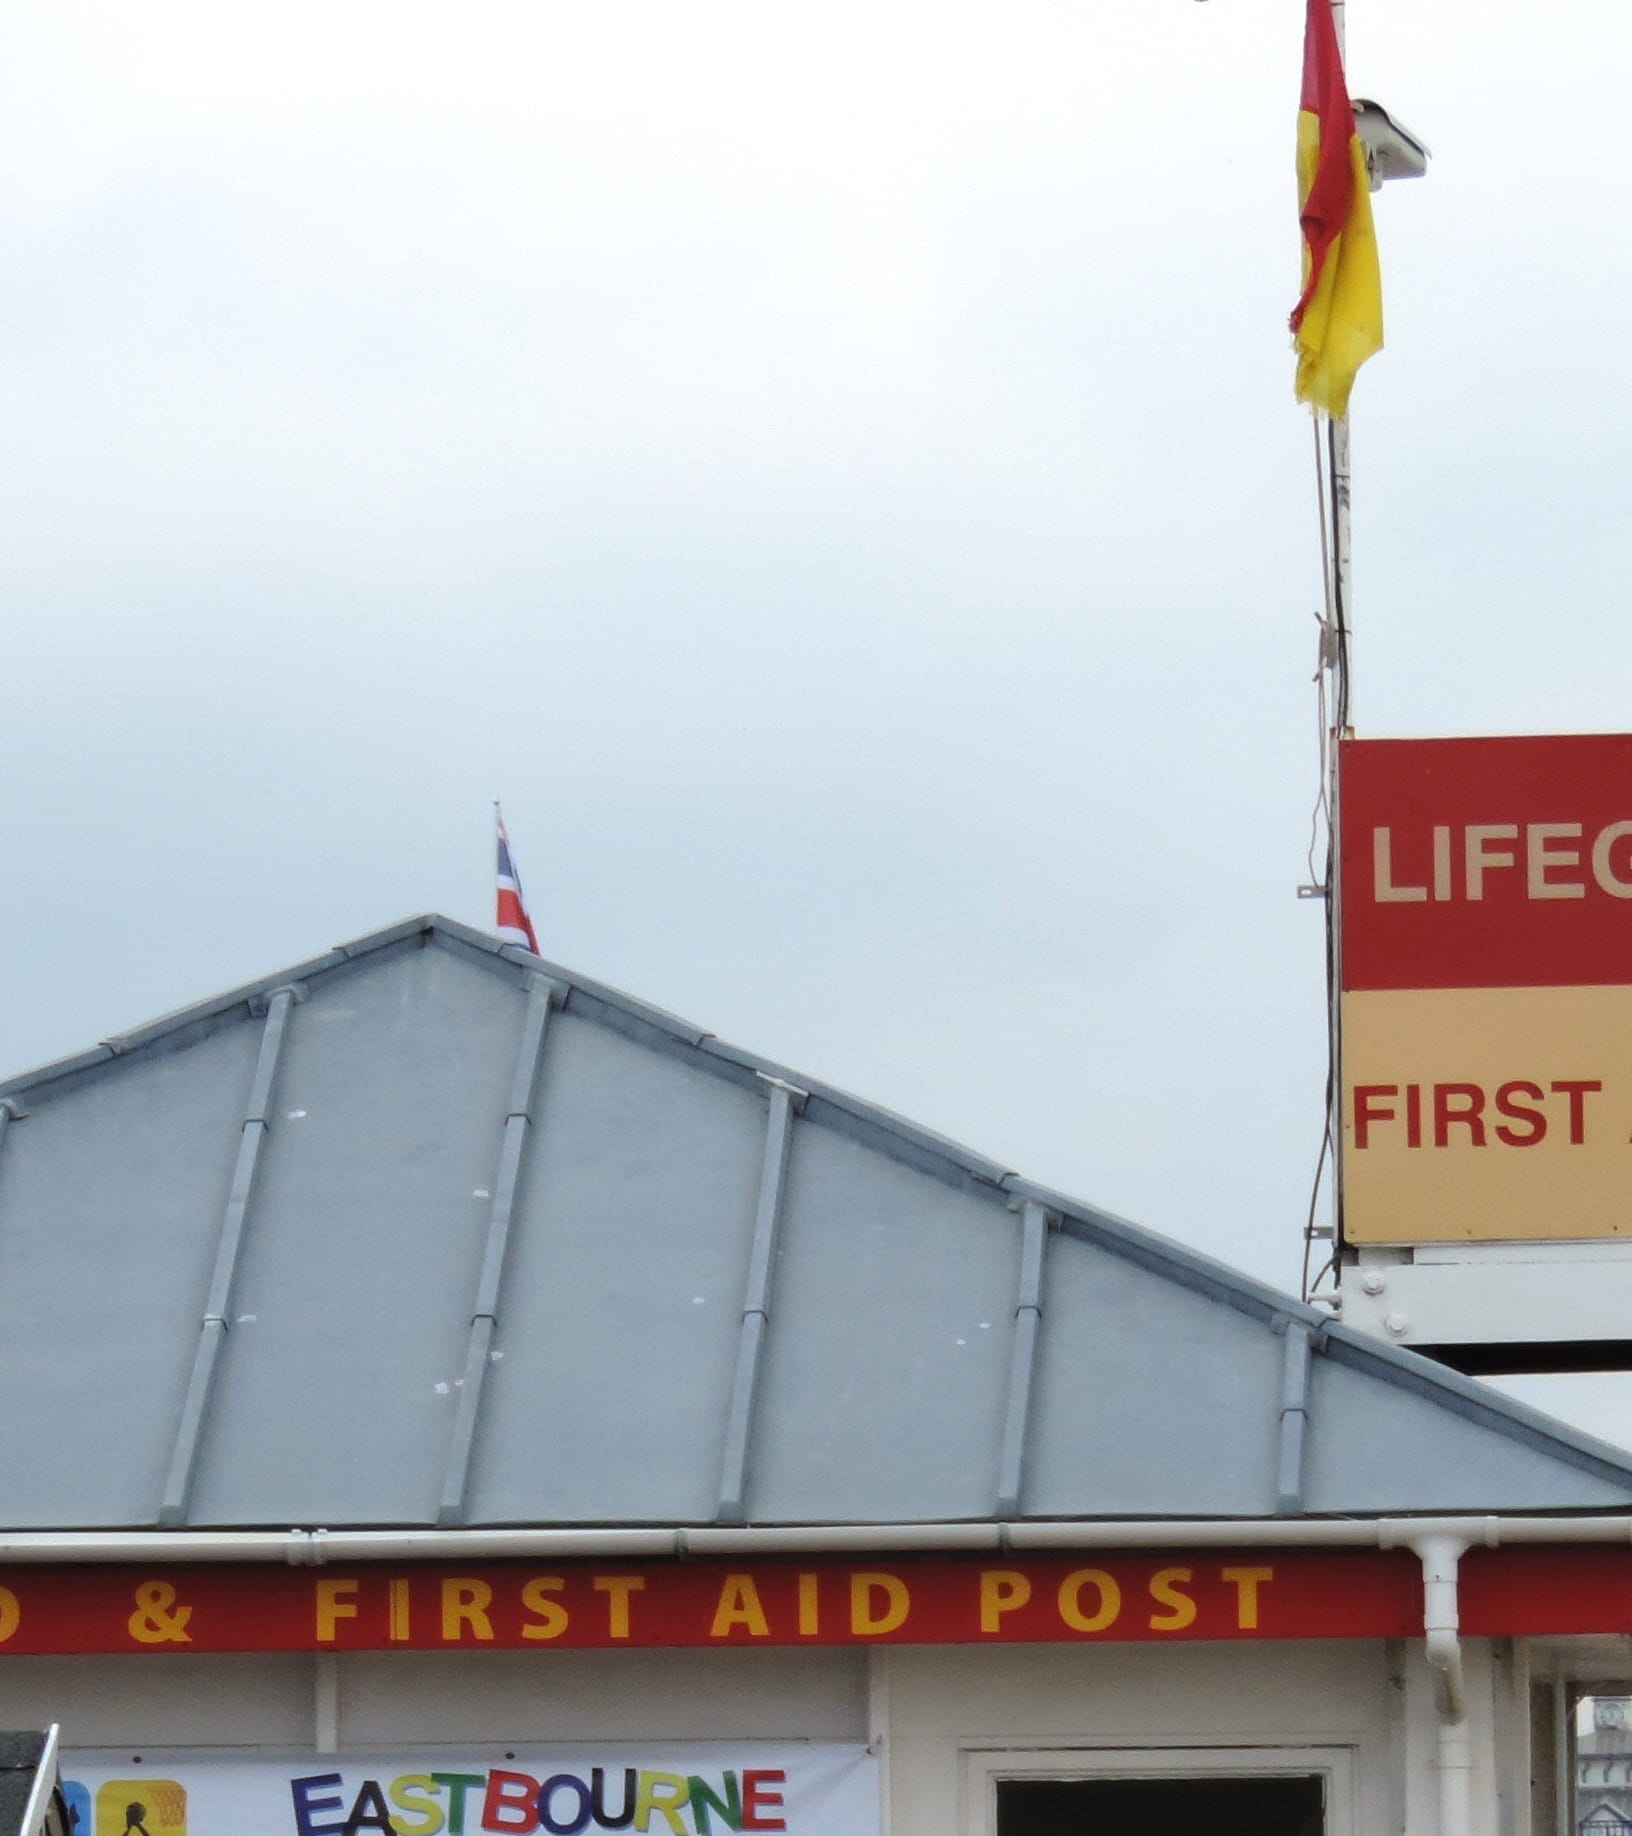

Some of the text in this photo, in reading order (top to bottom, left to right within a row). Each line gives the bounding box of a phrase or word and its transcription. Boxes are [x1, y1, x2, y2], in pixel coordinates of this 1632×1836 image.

[1353, 1080, 1602, 1150] FIRST
[128, 1581, 193, 1645] &
[314, 1576, 646, 1642] FIRST
[709, 1572, 911, 1638] AID
[979, 1566, 1274, 1634] POST
